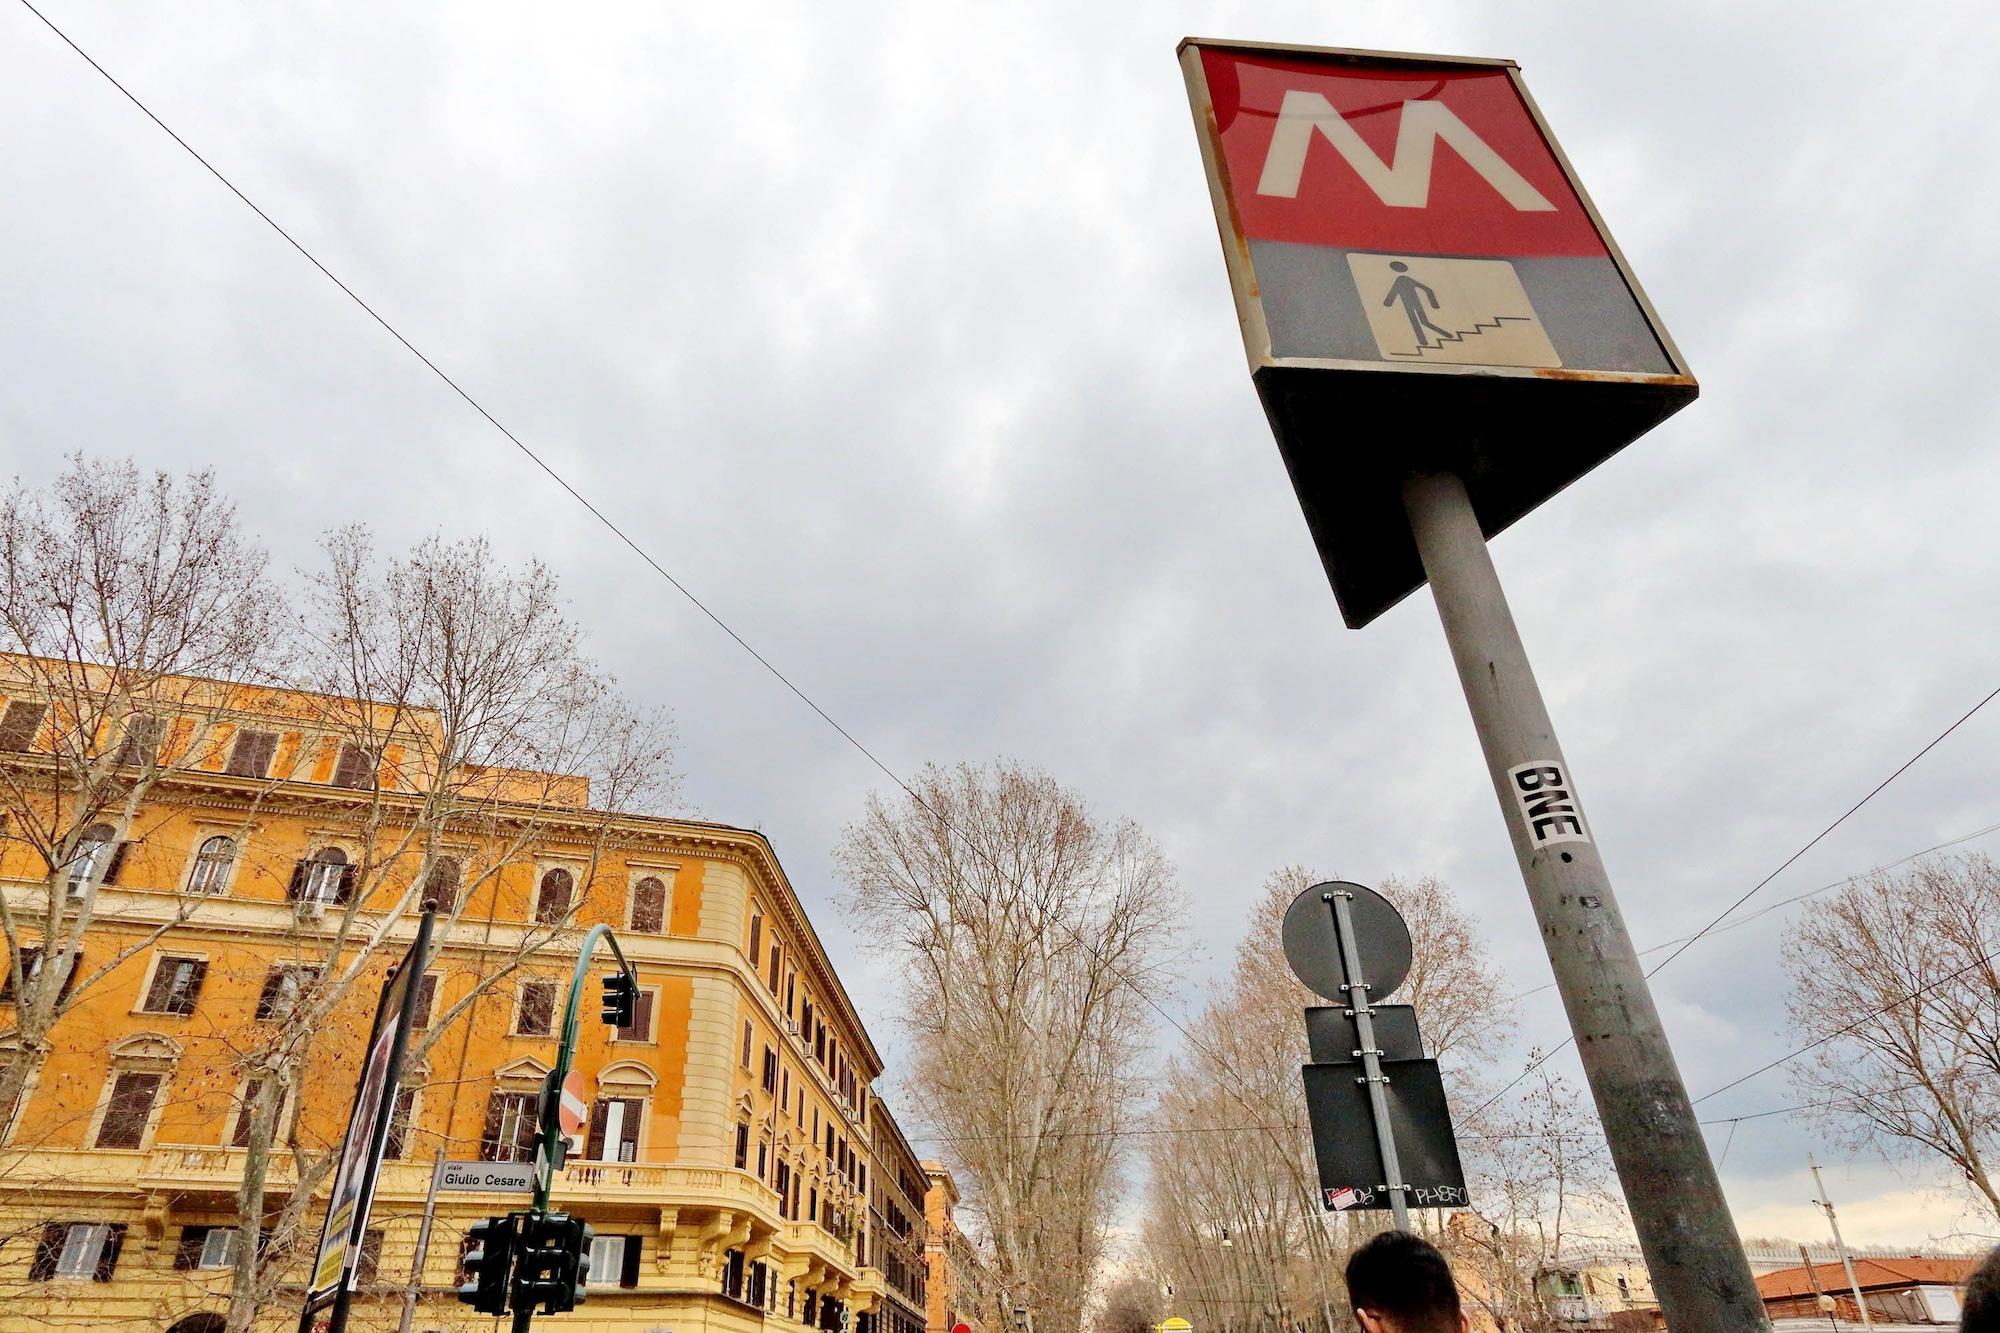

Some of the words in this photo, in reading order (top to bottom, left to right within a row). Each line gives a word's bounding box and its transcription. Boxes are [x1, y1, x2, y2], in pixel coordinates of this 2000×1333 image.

[1257, 90, 1557, 212] M
[1515, 767, 1582, 840] BNE
[445, 1174, 480, 1185] Giulio
[485, 1174, 526, 1187] Cesare
